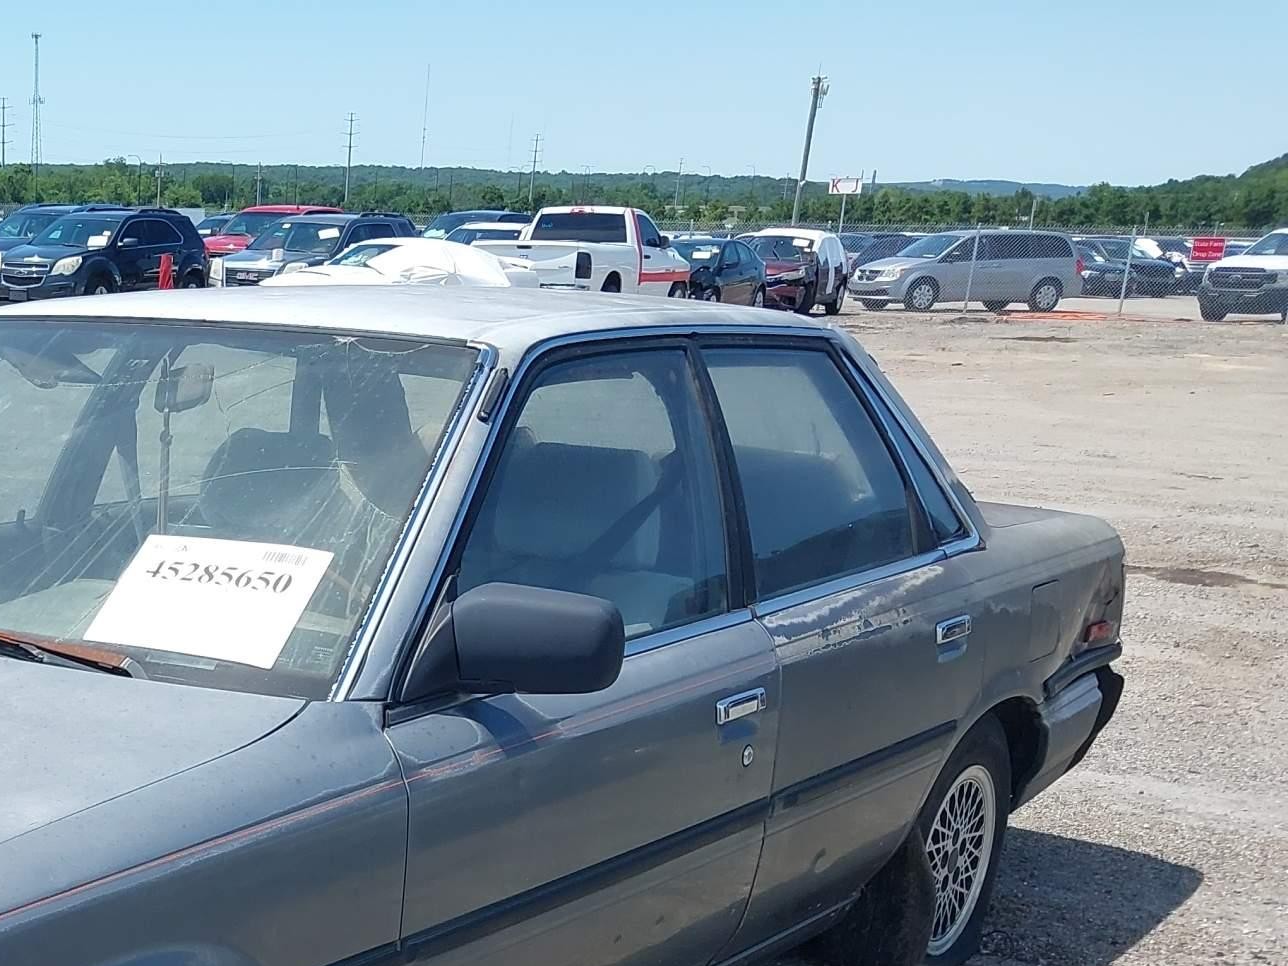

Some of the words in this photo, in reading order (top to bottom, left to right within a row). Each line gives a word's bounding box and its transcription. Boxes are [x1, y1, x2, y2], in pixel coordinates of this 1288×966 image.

[831, 178, 841, 193] K
[851, 178, 859, 193] J
[236, 272, 259, 281] GMC
[145, 560, 293, 594] 45285650
